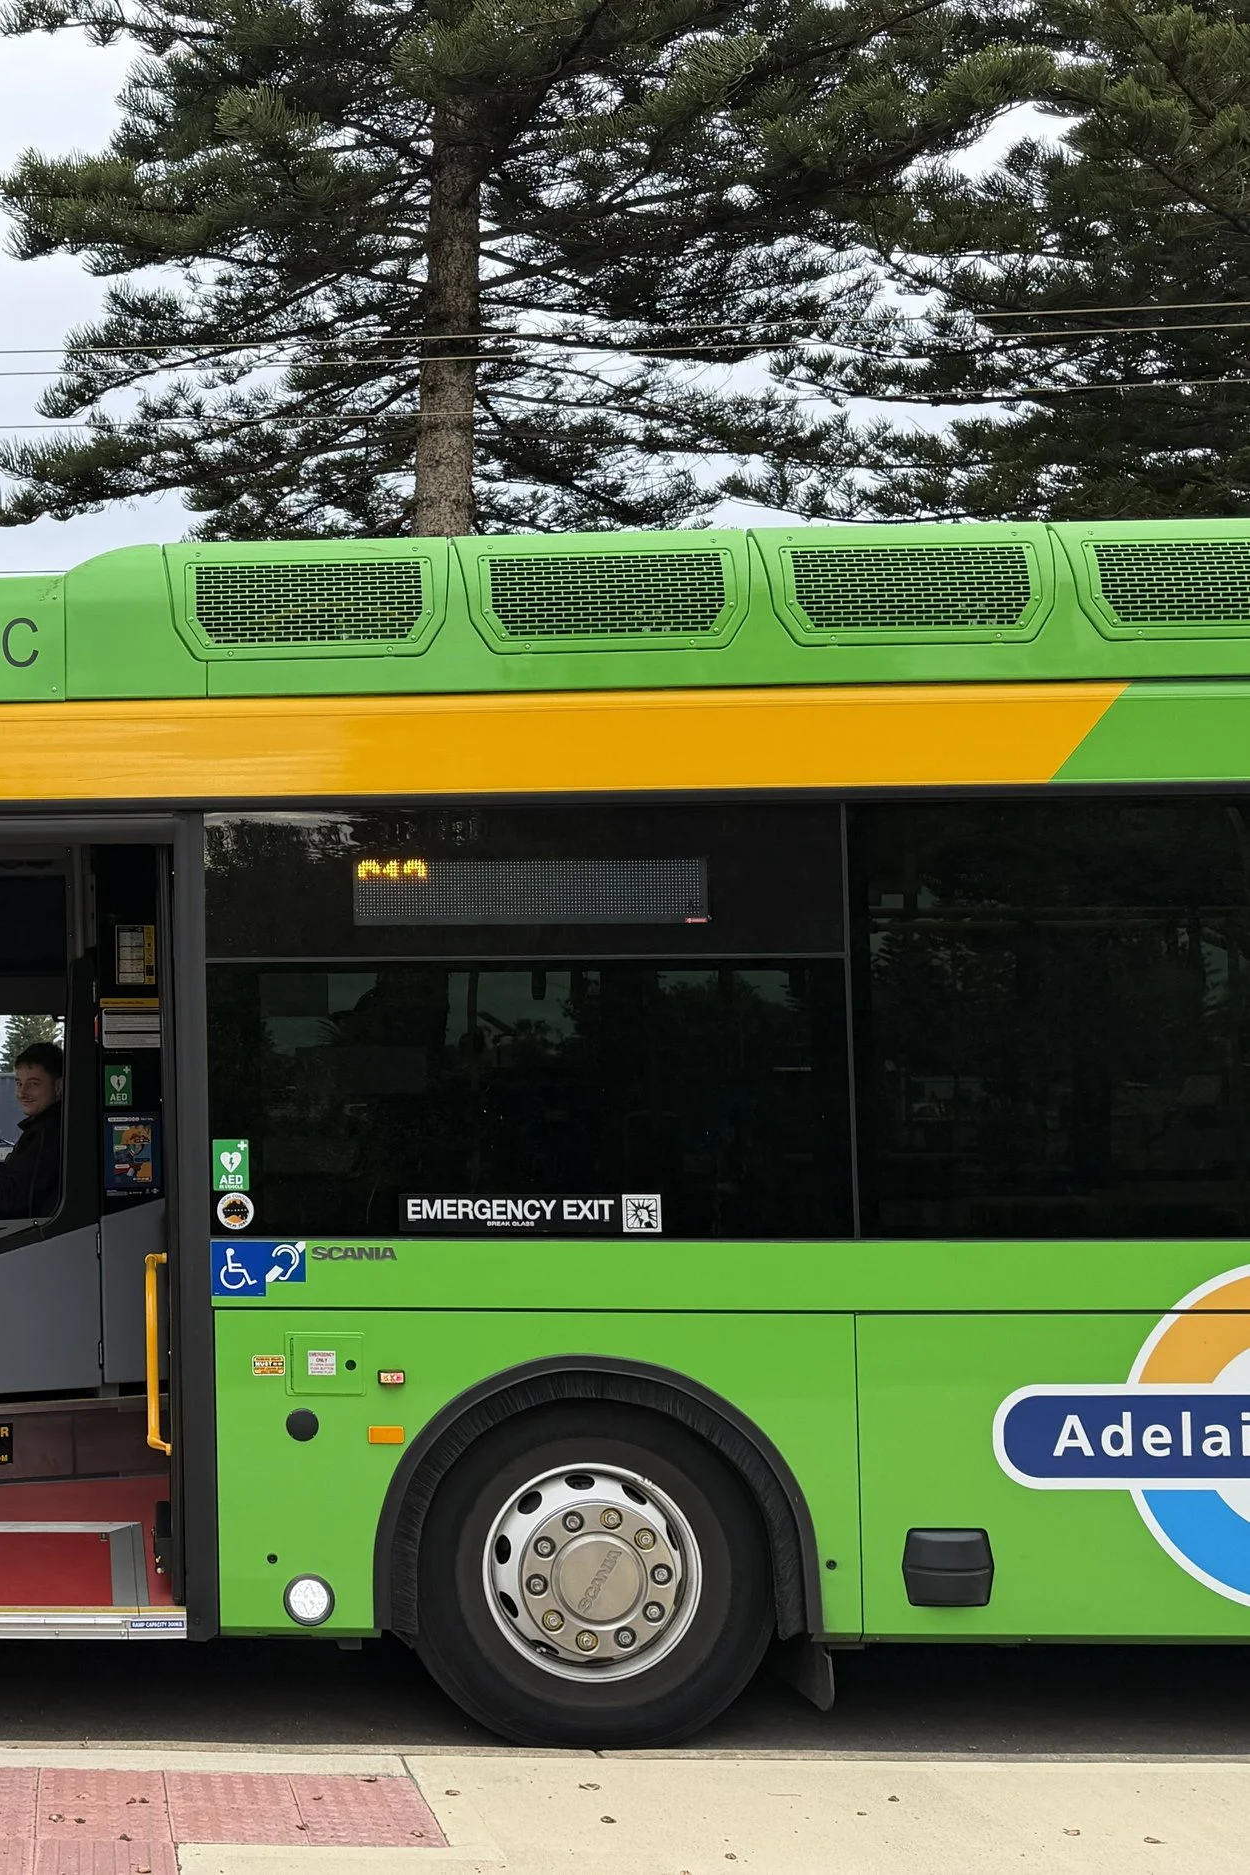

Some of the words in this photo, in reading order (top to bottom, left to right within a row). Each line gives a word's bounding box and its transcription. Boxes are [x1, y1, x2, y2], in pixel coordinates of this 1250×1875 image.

[110, 1093, 128, 1101] AED
[220, 1174, 243, 1184] AED
[407, 1199, 556, 1221] EMERGENCY
[563, 1200, 614, 1220] EXIT
[311, 1246, 397, 1262] SCANIA
[1053, 1411, 1250, 1458] Adelai
[578, 1550, 622, 1613] SCANIA
